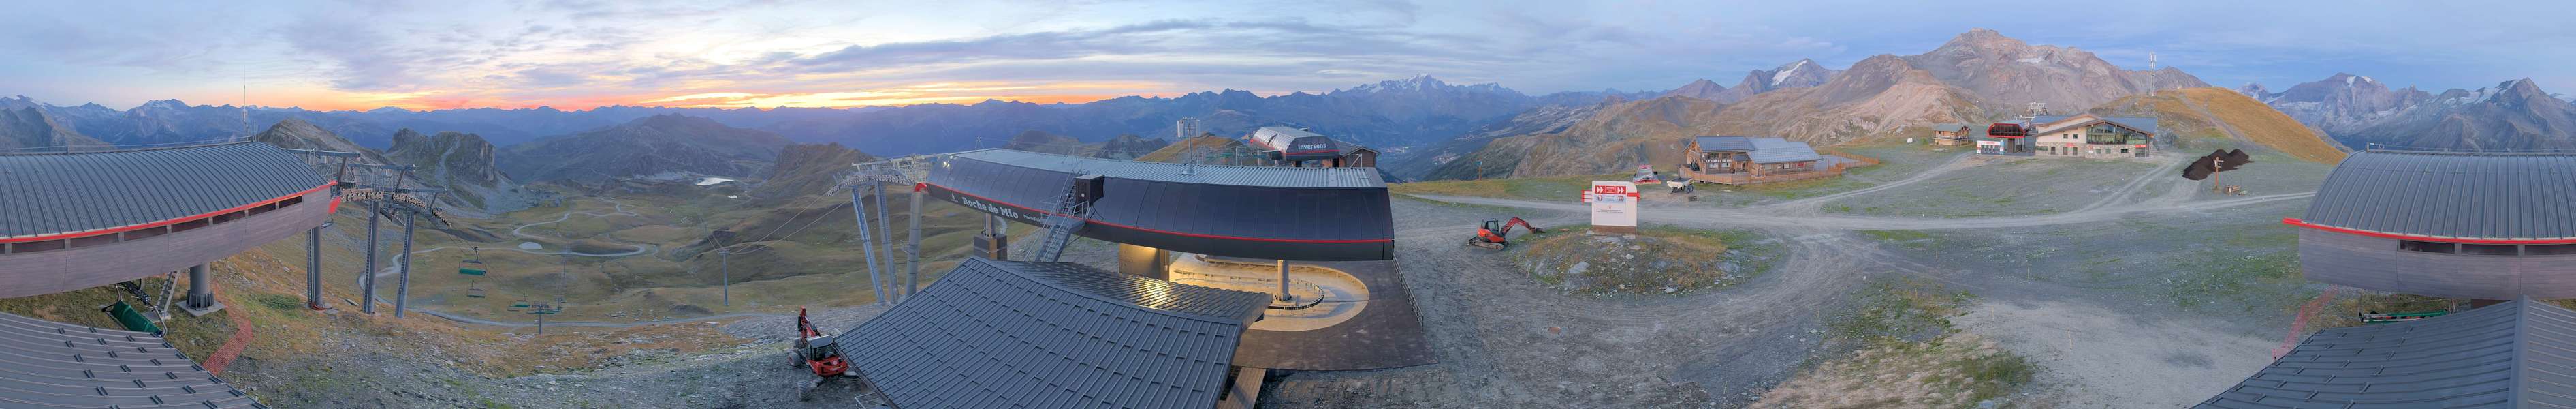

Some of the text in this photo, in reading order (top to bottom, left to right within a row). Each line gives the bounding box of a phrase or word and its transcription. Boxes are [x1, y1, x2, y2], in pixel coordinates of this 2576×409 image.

[962, 197, 987, 210] Roche
[988, 204, 999, 214] de
[1000, 207, 1019, 219] Mio
